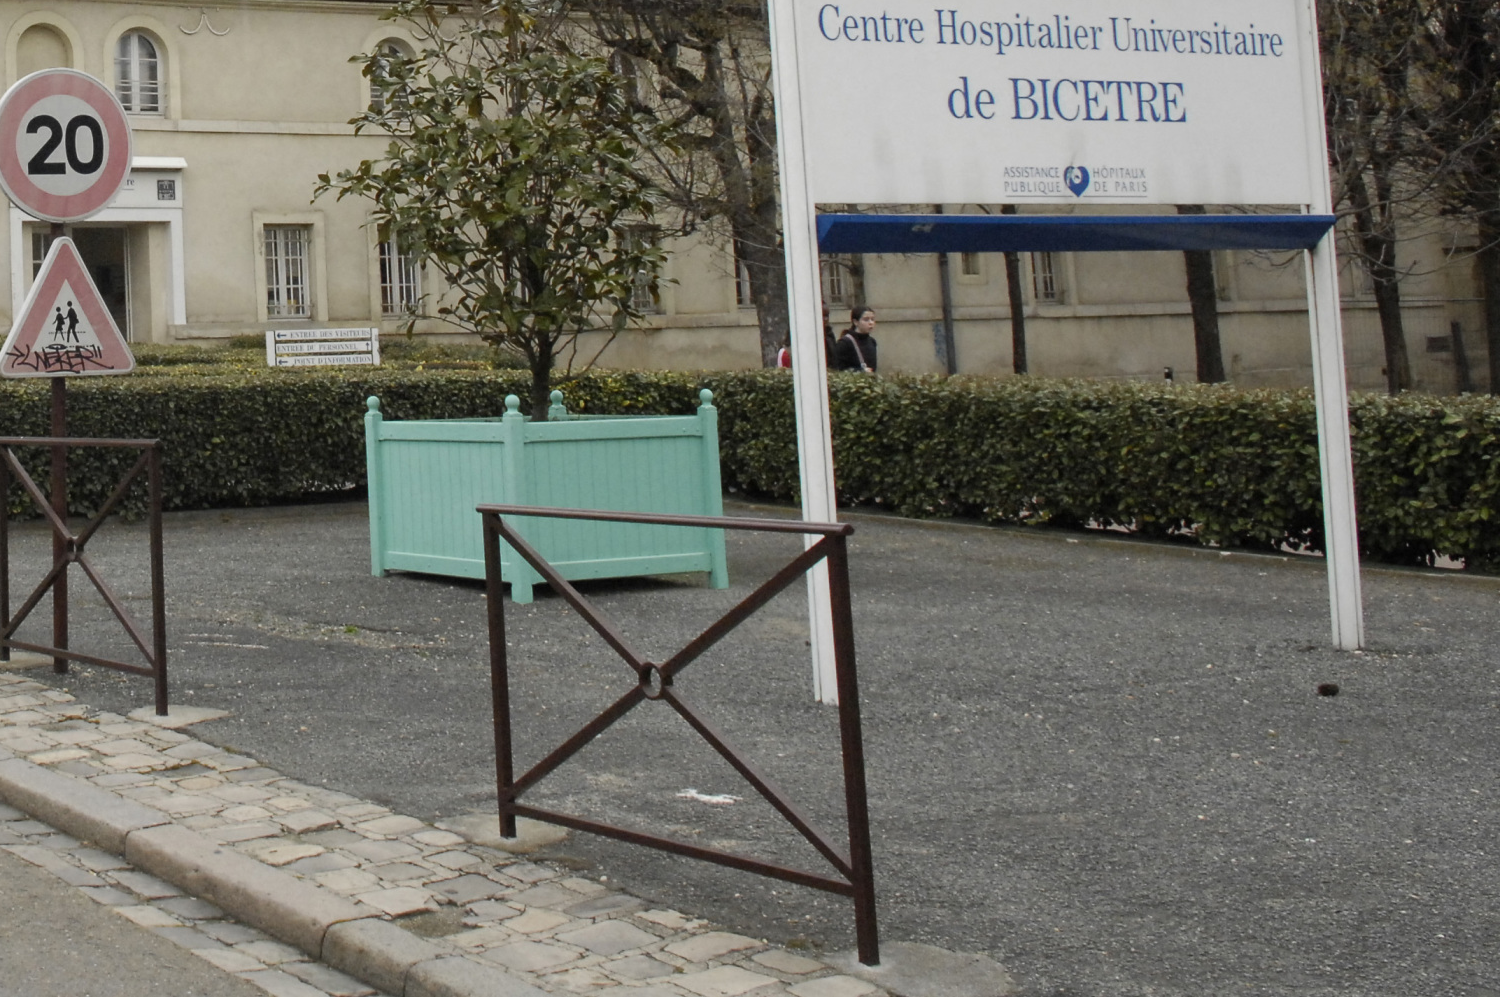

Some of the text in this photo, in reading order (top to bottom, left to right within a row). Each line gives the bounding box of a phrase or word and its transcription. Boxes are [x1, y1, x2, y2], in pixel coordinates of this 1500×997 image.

[818, 3, 1284, 57] Centre Hospitalier Universitaire
[947, 76, 1187, 123] de BICETRE
[26, 114, 104, 175] 20
[1003, 166, 1060, 179] ASSISTANCE
[1093, 165, 1146, 179] HÔPITAUX
[1004, 181, 1061, 195] PUBLIQUE
[1094, 181, 1148, 193] DE PARIS
[320, 329, 333, 338] DES
[334, 328, 371, 337] VISITEURS
[307, 343, 315, 351] DU
[318, 342, 358, 351] PERSONNEL
[294, 356, 372, 365] POINT D'INFORMATION
